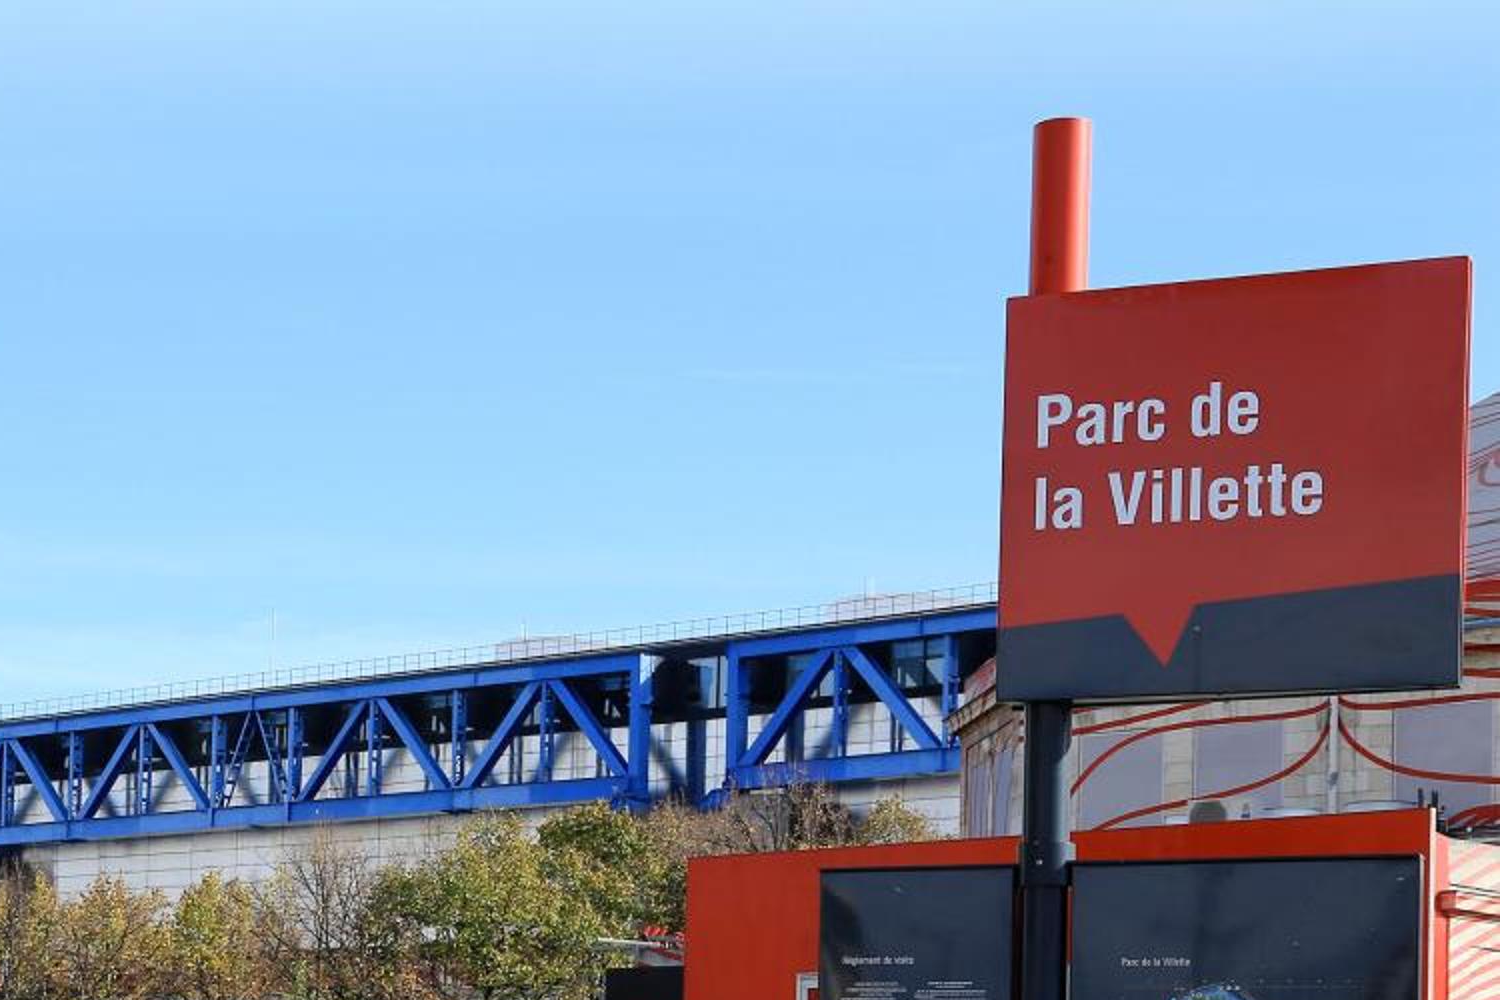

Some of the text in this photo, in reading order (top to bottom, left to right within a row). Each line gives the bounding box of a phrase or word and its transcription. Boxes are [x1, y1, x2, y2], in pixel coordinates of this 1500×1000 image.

[1037, 381, 1260, 448] Parc de
[1035, 463, 1324, 531] la Villette
